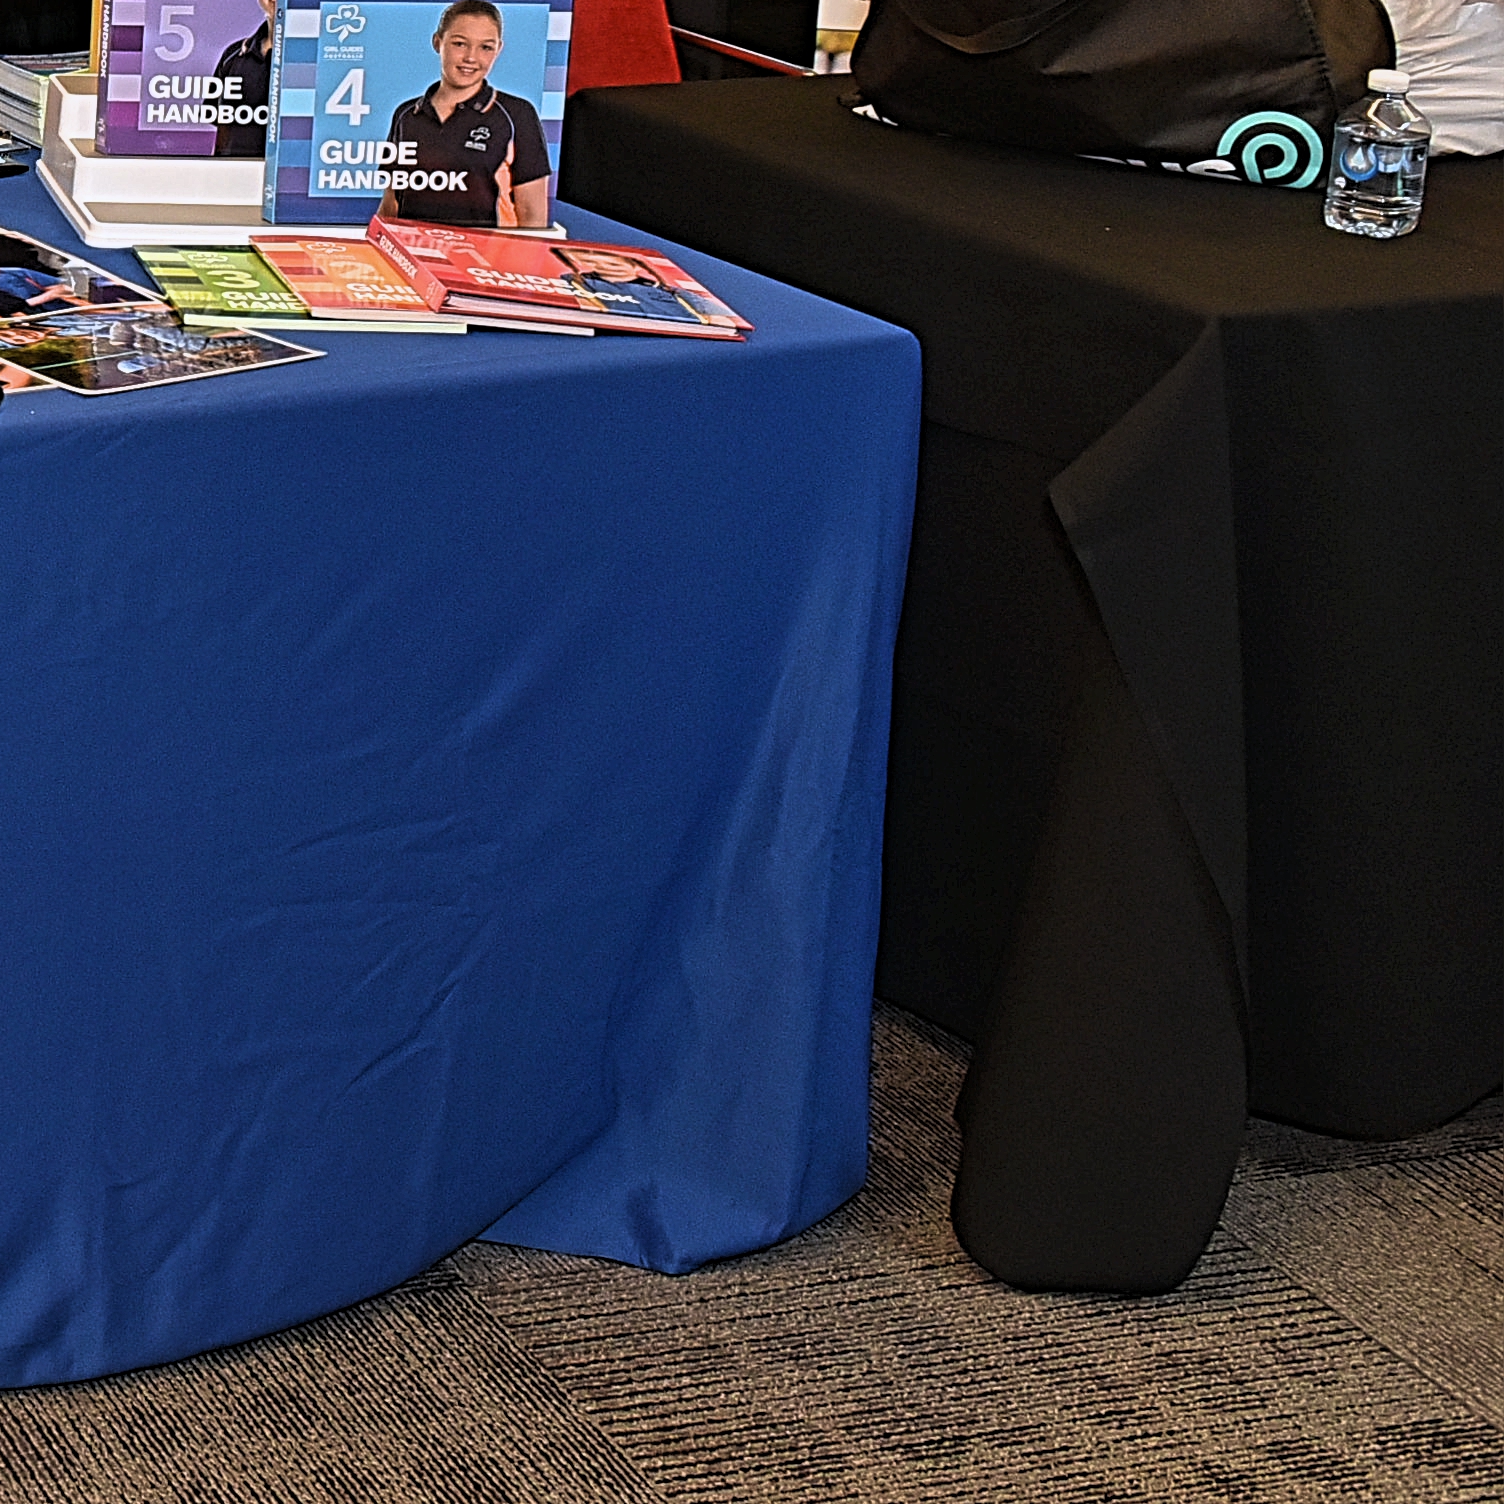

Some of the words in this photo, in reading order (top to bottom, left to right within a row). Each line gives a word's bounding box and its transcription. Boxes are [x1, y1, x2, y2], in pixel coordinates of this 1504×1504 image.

[154, 4, 195, 63] 5
[148, 74, 243, 100] GUIDE
[324, 68, 371, 126] 4
[146, 103, 269, 126] HANDBOO
[319, 139, 418, 166] GUIDE
[317, 169, 469, 192] HANDBOOK
[205, 269, 261, 289] 3
[345, 282, 417, 295] GUI
[466, 266, 575, 289] GUIDE
[474, 276, 641, 305] HANDBOOK
[227, 300, 308, 311] HAND
